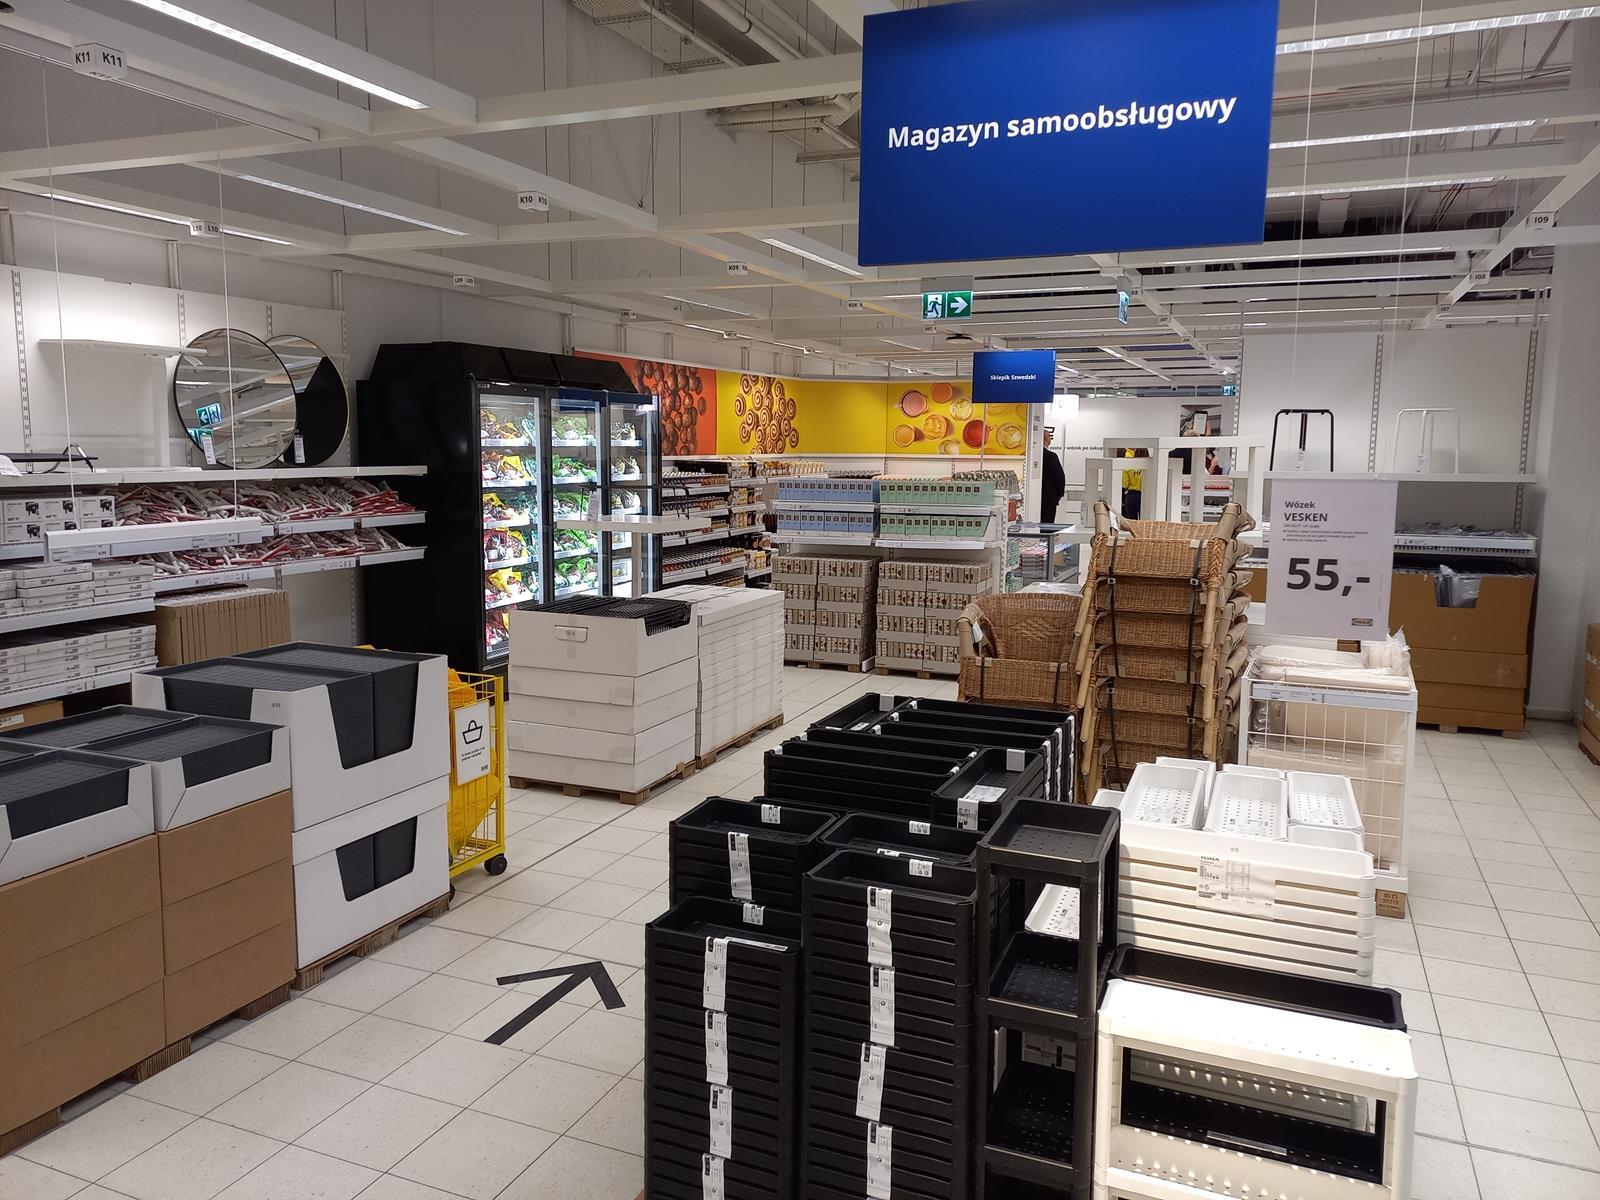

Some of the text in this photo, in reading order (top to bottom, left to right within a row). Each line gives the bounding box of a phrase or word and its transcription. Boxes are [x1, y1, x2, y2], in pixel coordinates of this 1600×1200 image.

[75, 51, 90, 64] K11
[102, 51, 122, 68] K11
[888, 97, 1237, 150] Magazyn samoobsługowy
[520, 195, 533, 203] K10
[1284, 500, 1316, 509] Wózek
[1283, 512, 1328, 522] VESKEN
[1286, 557, 1371, 597] 55,-
